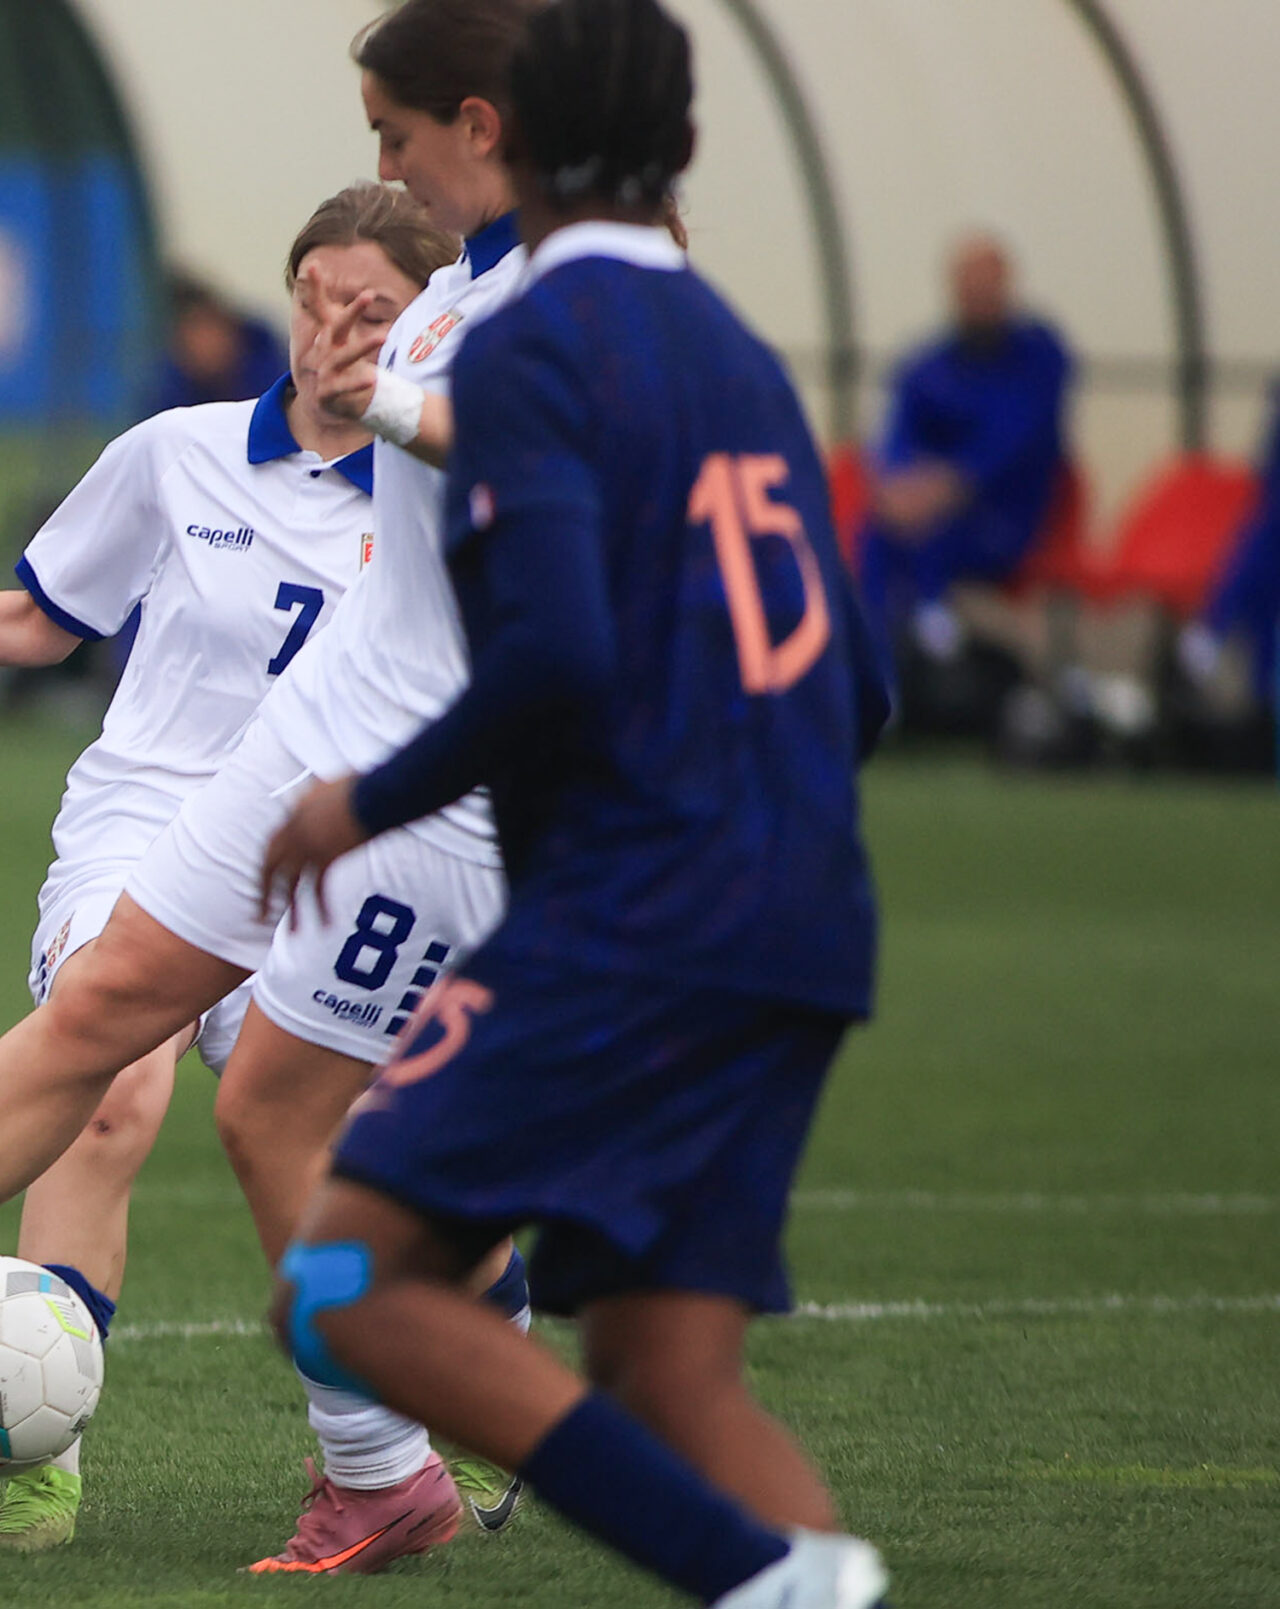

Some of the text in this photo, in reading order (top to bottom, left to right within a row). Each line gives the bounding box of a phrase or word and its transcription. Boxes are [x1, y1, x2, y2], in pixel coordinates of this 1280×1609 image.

[186, 524, 254, 546] capelli
[686, 452, 829, 695] 15
[267, 581, 325, 676] 7
[333, 893, 417, 992] 8
[313, 989, 384, 1026] capelli
